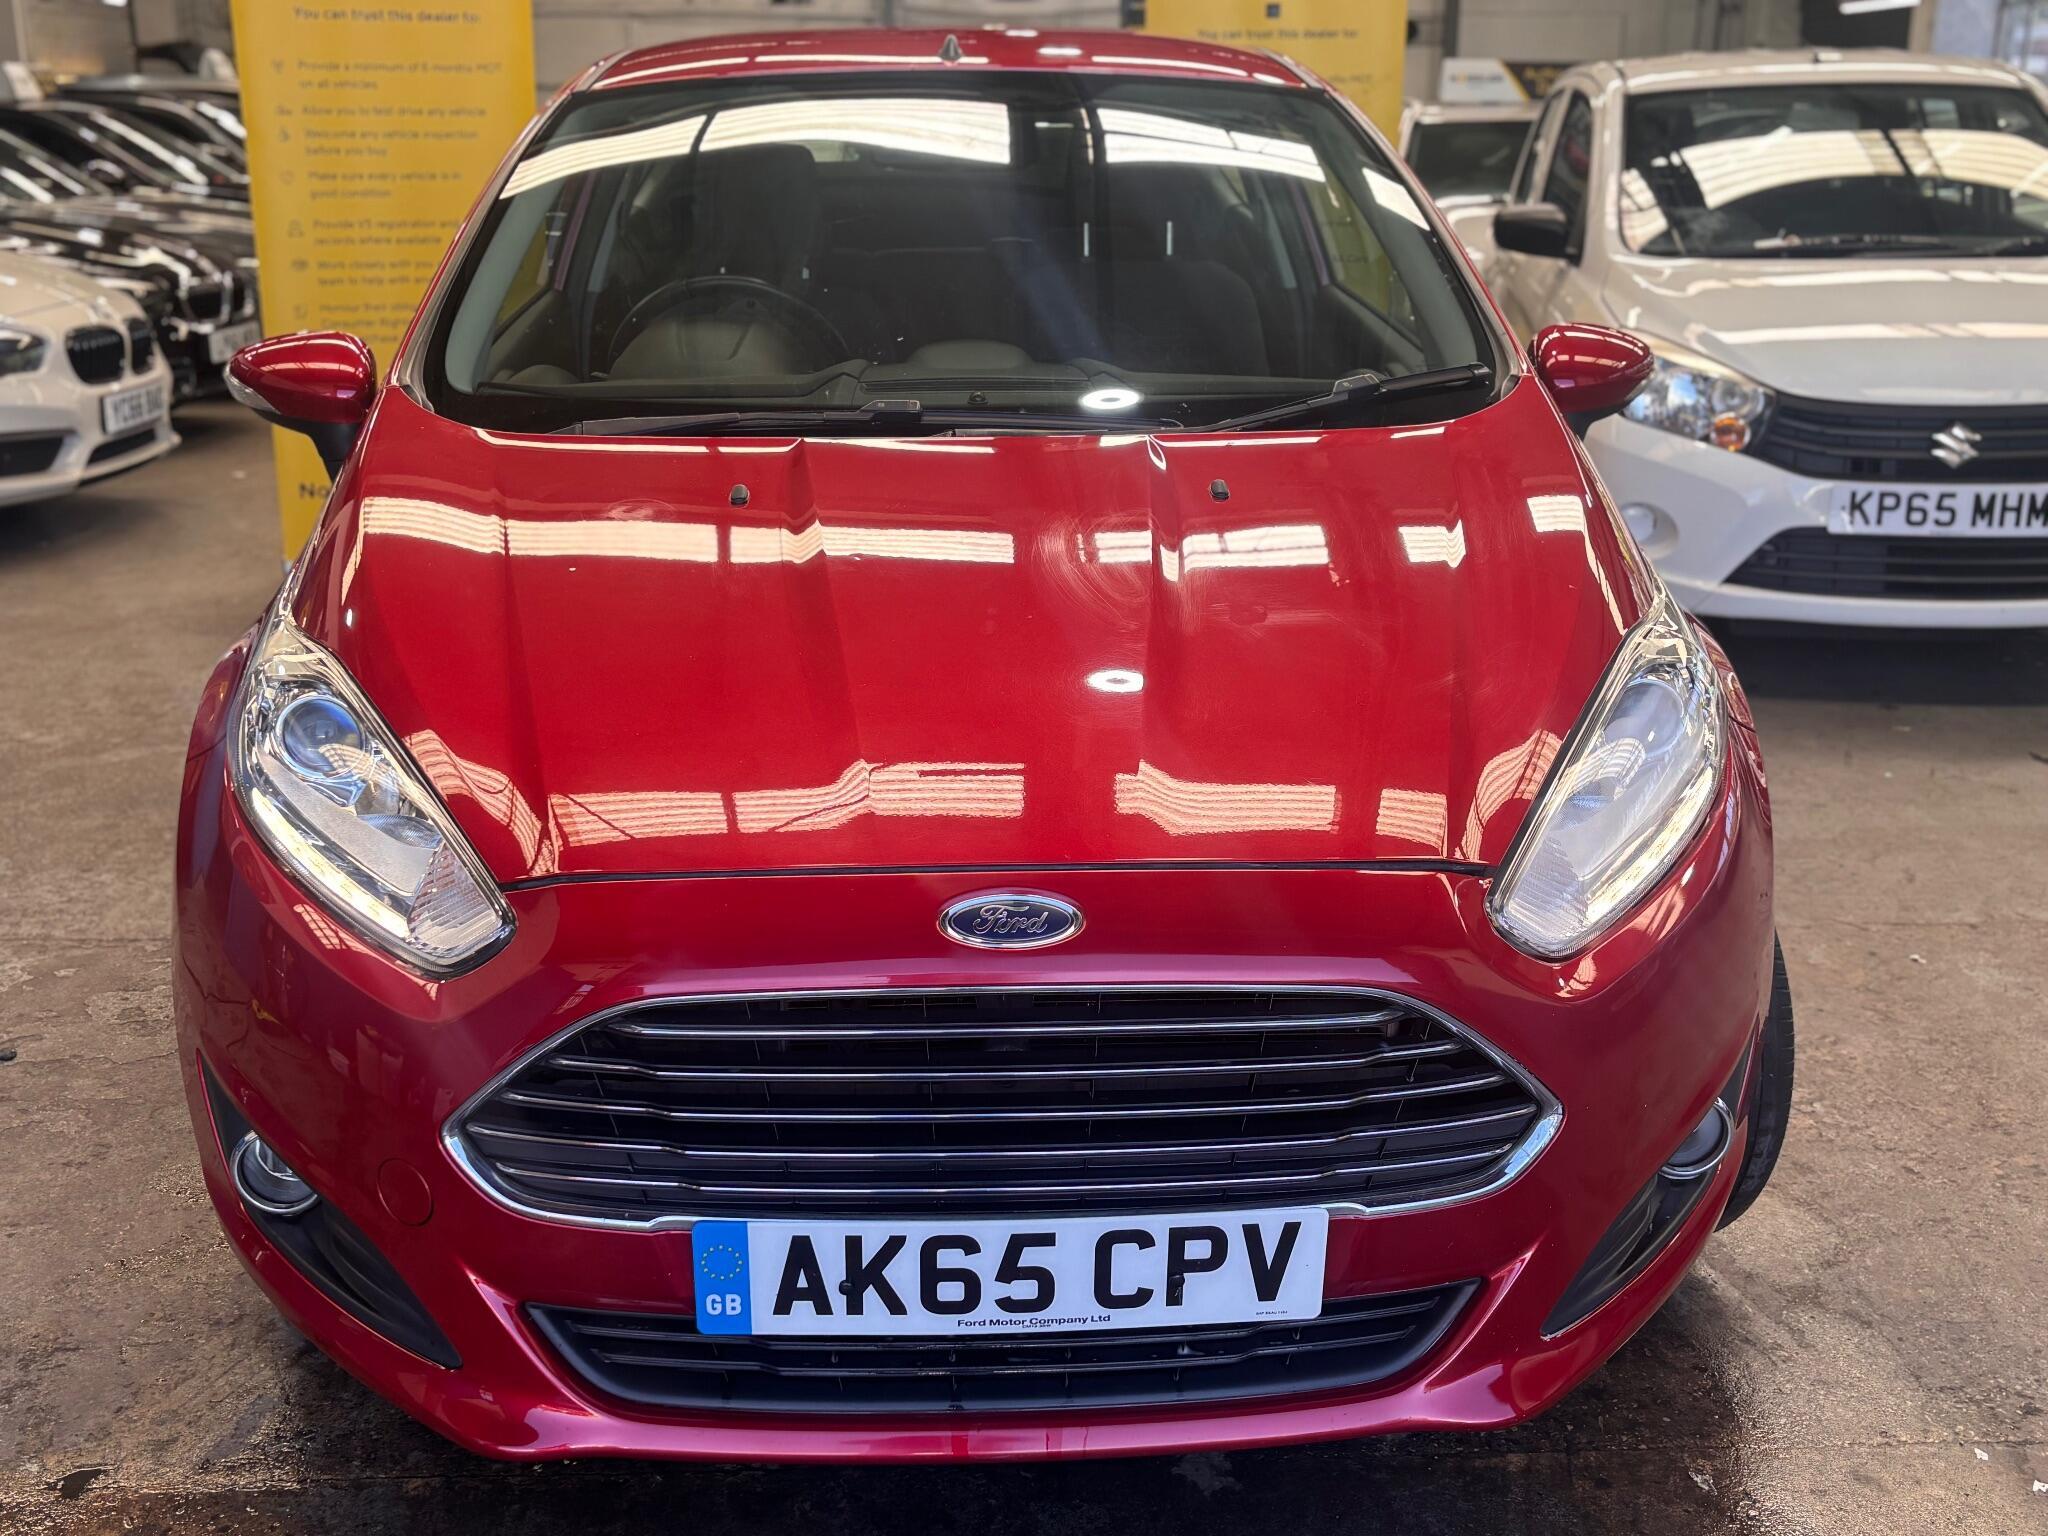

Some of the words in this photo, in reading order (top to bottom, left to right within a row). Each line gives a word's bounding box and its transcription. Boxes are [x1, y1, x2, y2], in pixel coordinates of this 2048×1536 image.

[294, 7, 319, 20] You
[323, 8, 347, 21] can
[351, 8, 383, 21] trust
[388, 9, 412, 22] this
[417, 10, 458, 22] dealer
[1223, 30, 1242, 38] can
[1279, 29, 1298, 38] this
[1304, 29, 1339, 38] dealer
[297, 58, 340, 71] Provide
[353, 61, 404, 72] minimum
[302, 105, 332, 116] Allow
[337, 107, 355, 117] you
[359, 106, 369, 115] to
[372, 105, 393, 115] test
[398, 106, 423, 116] drive
[427, 107, 445, 117] any
[449, 106, 486, 116] vehicle
[305, 129, 356, 138] Welcome
[360, 130, 378, 141] any
[383, 129, 419, 138] vehicle
[306, 146, 341, 156] before
[345, 147, 363, 157] you
[368, 146, 387, 157] buy
[308, 171, 337, 180] Make
[341, 172, 364, 180] sure
[368, 172, 396, 183] every
[400, 171, 436, 180] vehicle
[310, 188, 337, 199] good
[313, 219, 353, 229] Provide
[1850, 491, 1957, 527] KP65
[1971, 492, 2048, 528] MHM
[972, 904, 1049, 935] Ford
[772, 1231, 1057, 1316] AK65
[1093, 1221, 1303, 1310] CPV
[705, 1293, 742, 1316] GB
[957, 1319, 987, 1327] Ford
[989, 1318, 1027, 1327] Motor
[1029, 1315, 1089, 1326] Company
[1090, 1314, 1112, 1323] Ltd
